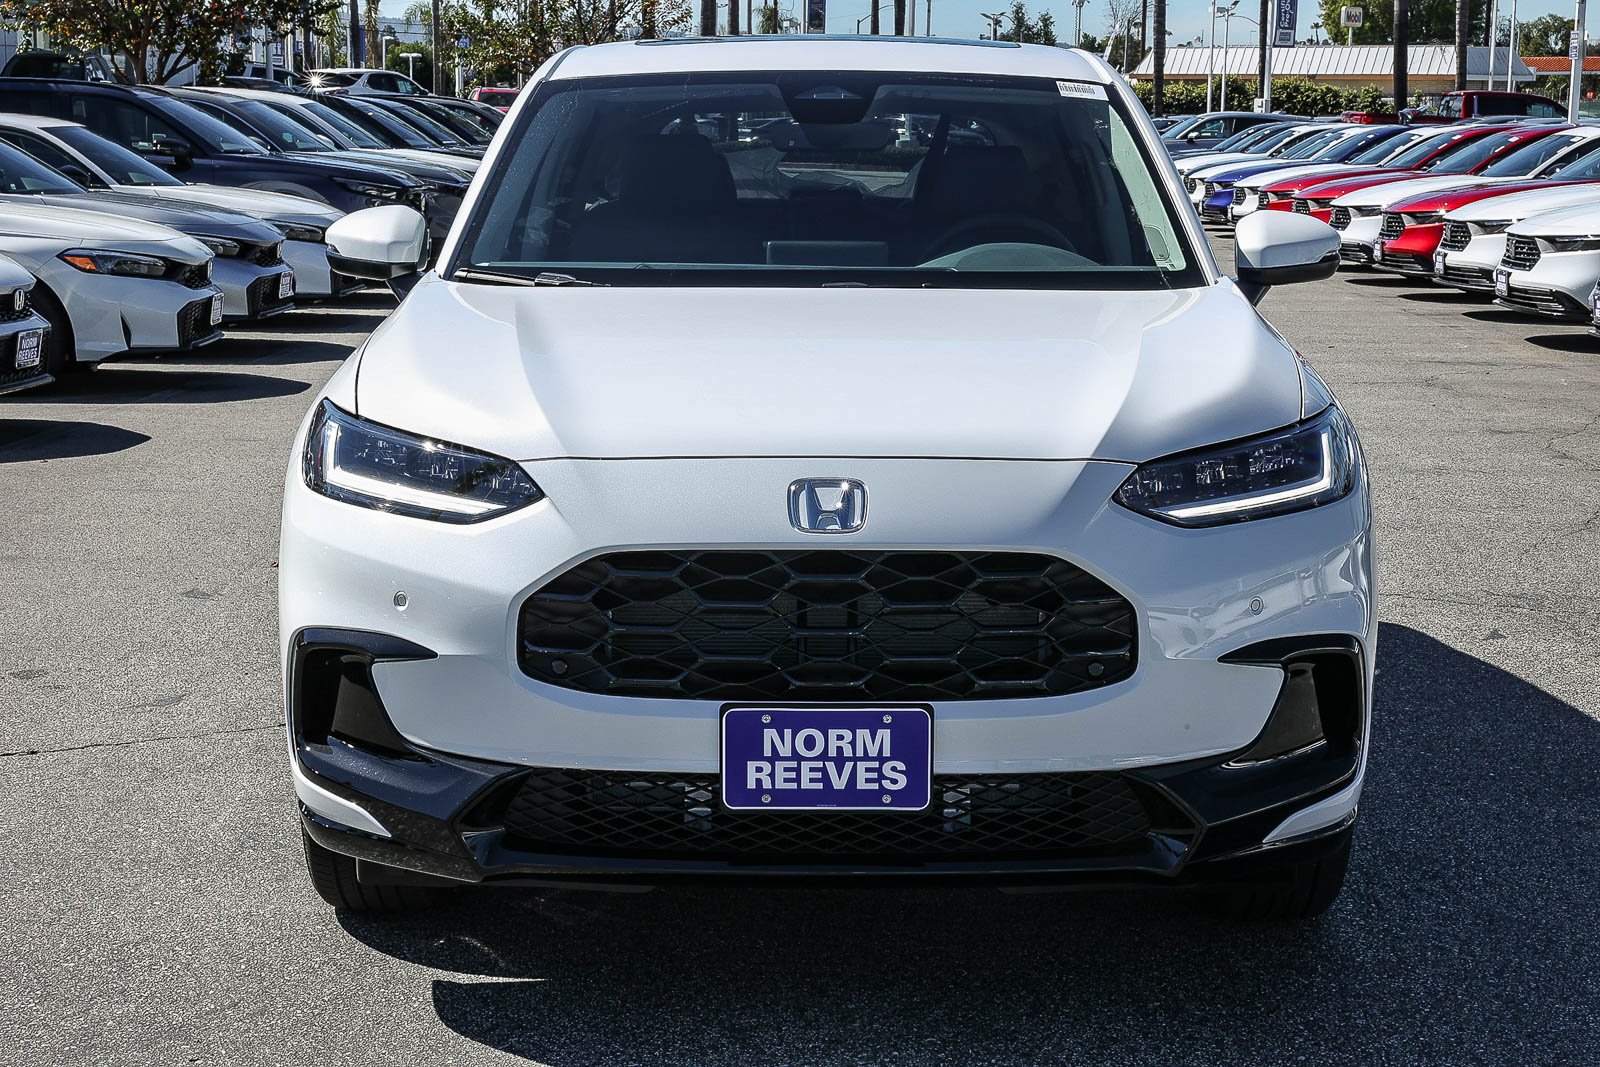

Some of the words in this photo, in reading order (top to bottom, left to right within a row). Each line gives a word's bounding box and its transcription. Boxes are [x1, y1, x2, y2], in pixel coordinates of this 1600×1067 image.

[22, 337, 37, 349] NORM
[19, 348, 37, 360] REEVES
[763, 728, 891, 757] NORM
[746, 760, 908, 790] REEVES
